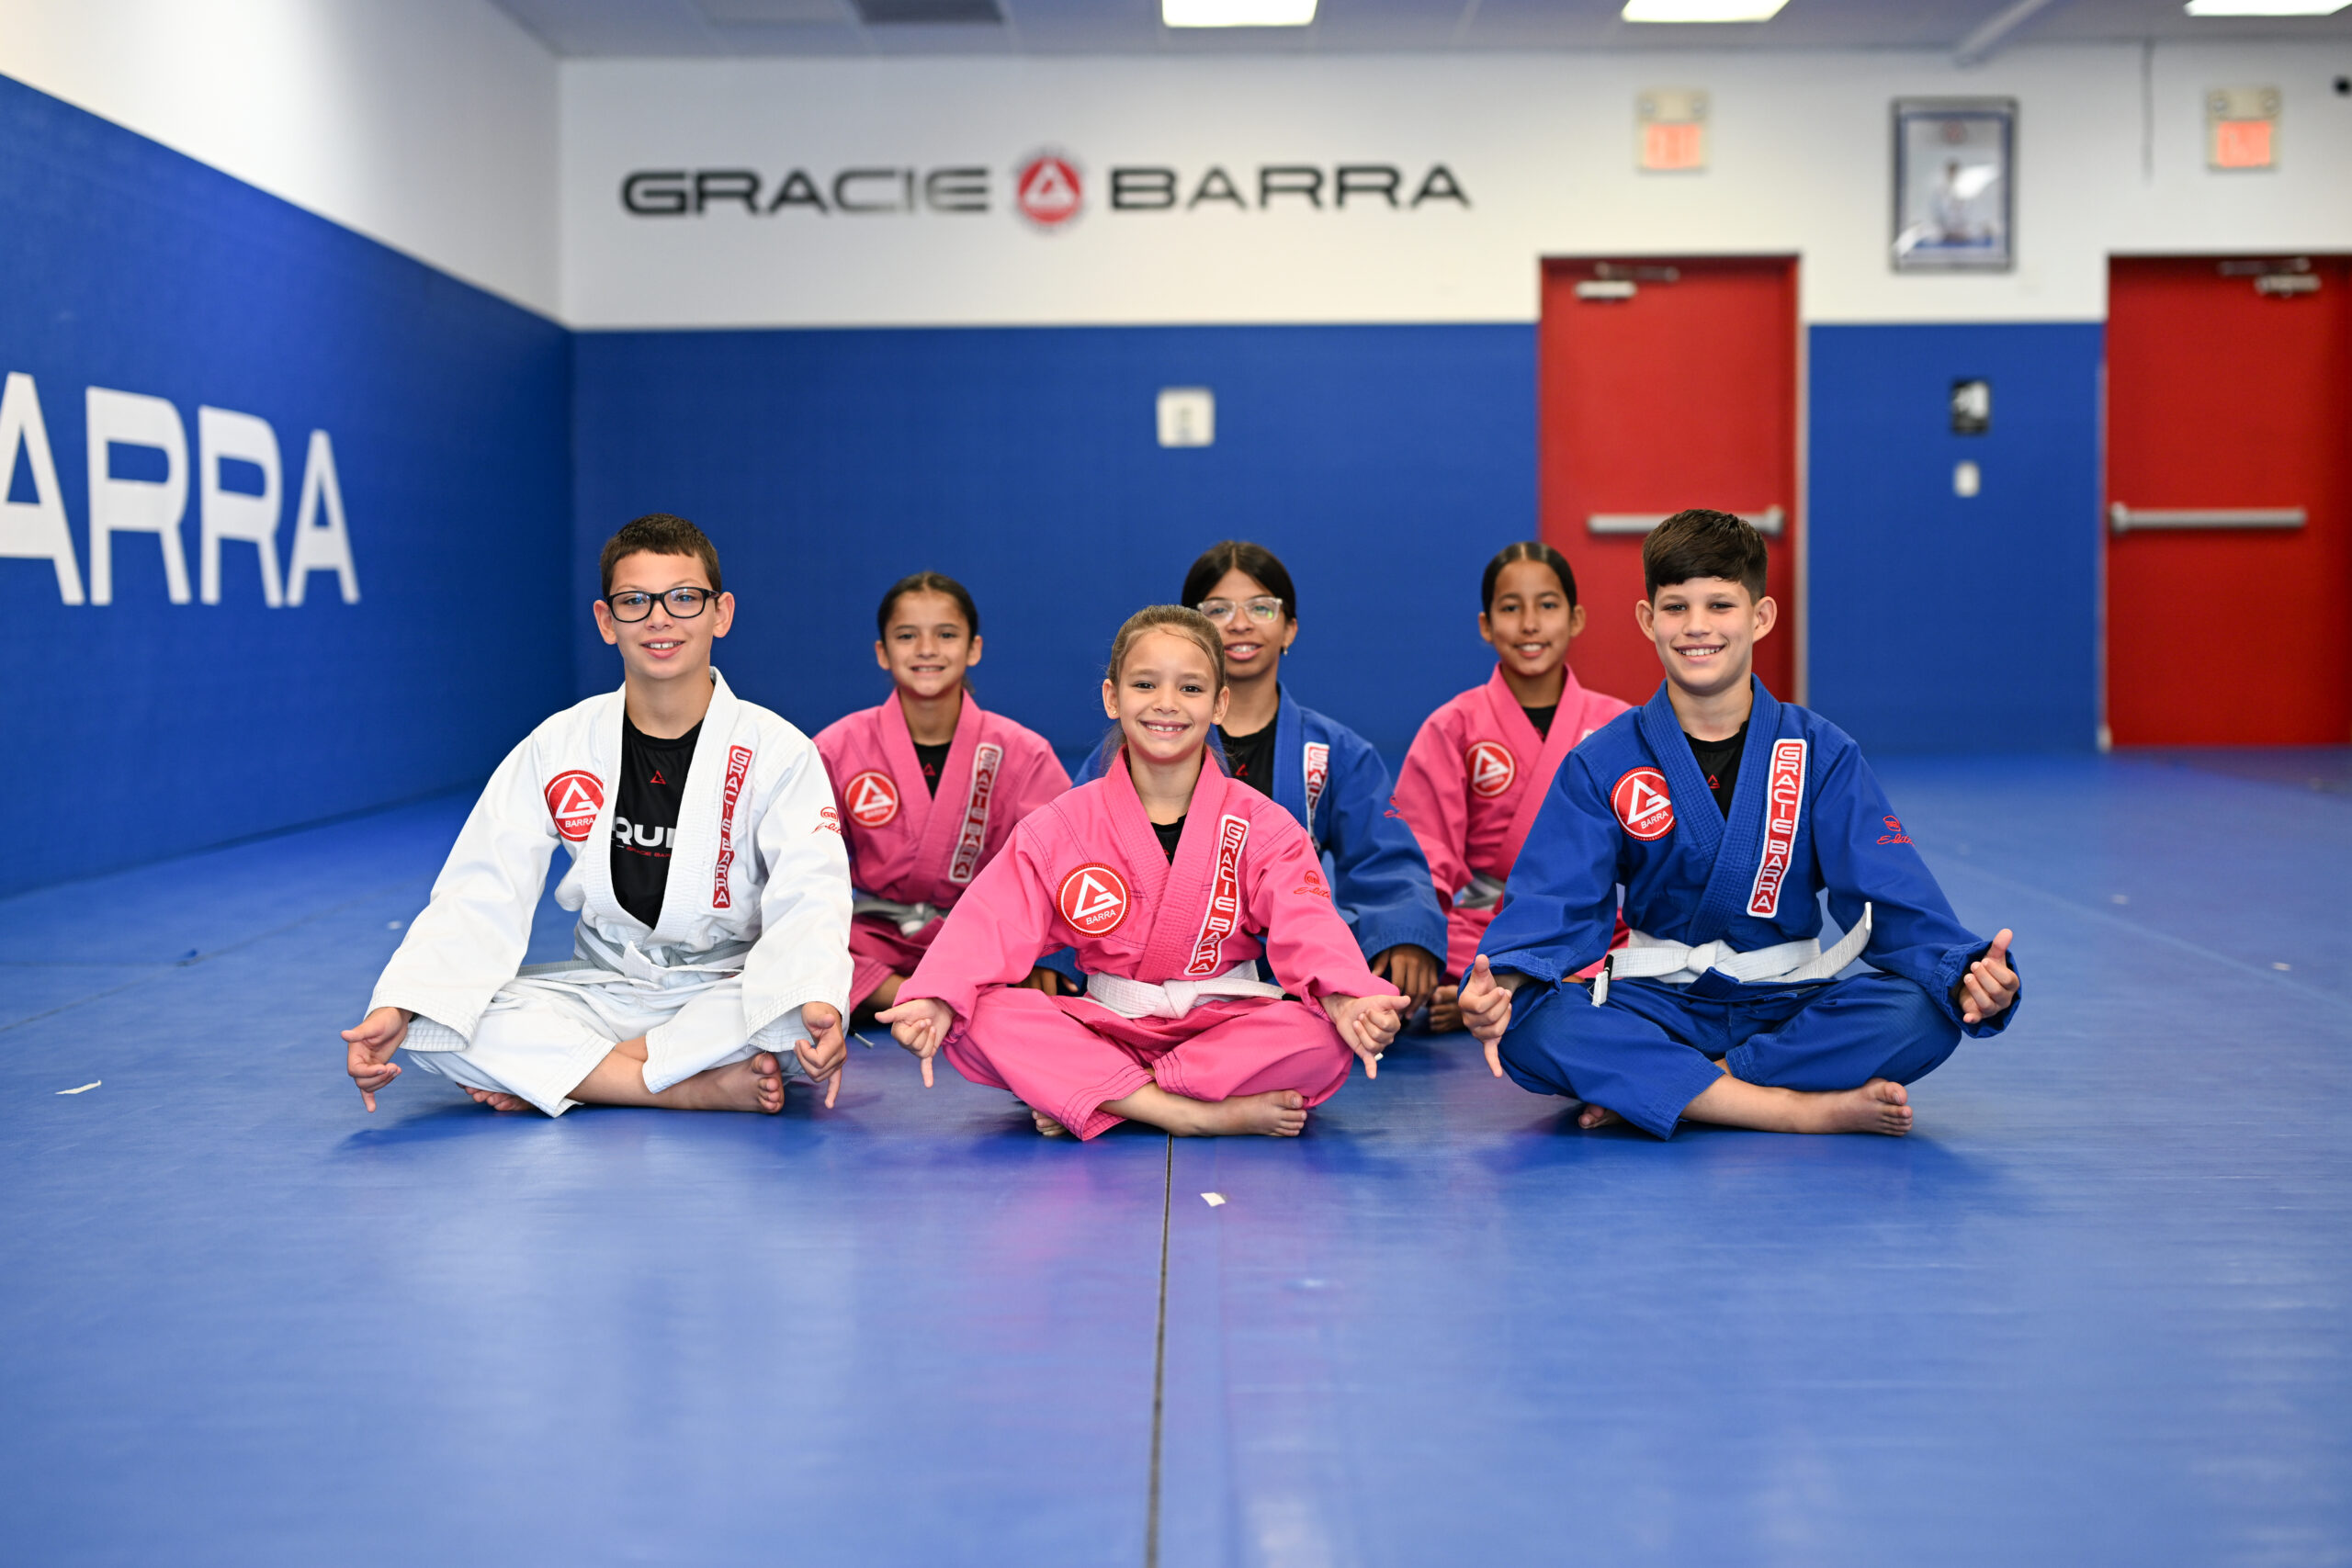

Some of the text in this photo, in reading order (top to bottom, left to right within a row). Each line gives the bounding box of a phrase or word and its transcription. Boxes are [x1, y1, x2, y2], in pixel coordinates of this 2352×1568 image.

[621, 169, 989, 217] GRACIE
[1109, 166, 1472, 212] BARRA
[565, 817, 594, 828] BARRA
[714, 749, 751, 906] GRACIE BARRA
[1640, 810, 1668, 829] BARRA
[1753, 746, 1801, 910] GRACIE BARRA
[1086, 908, 1116, 925] BARRA
[1189, 822, 1244, 972] GRACIE BARRA
